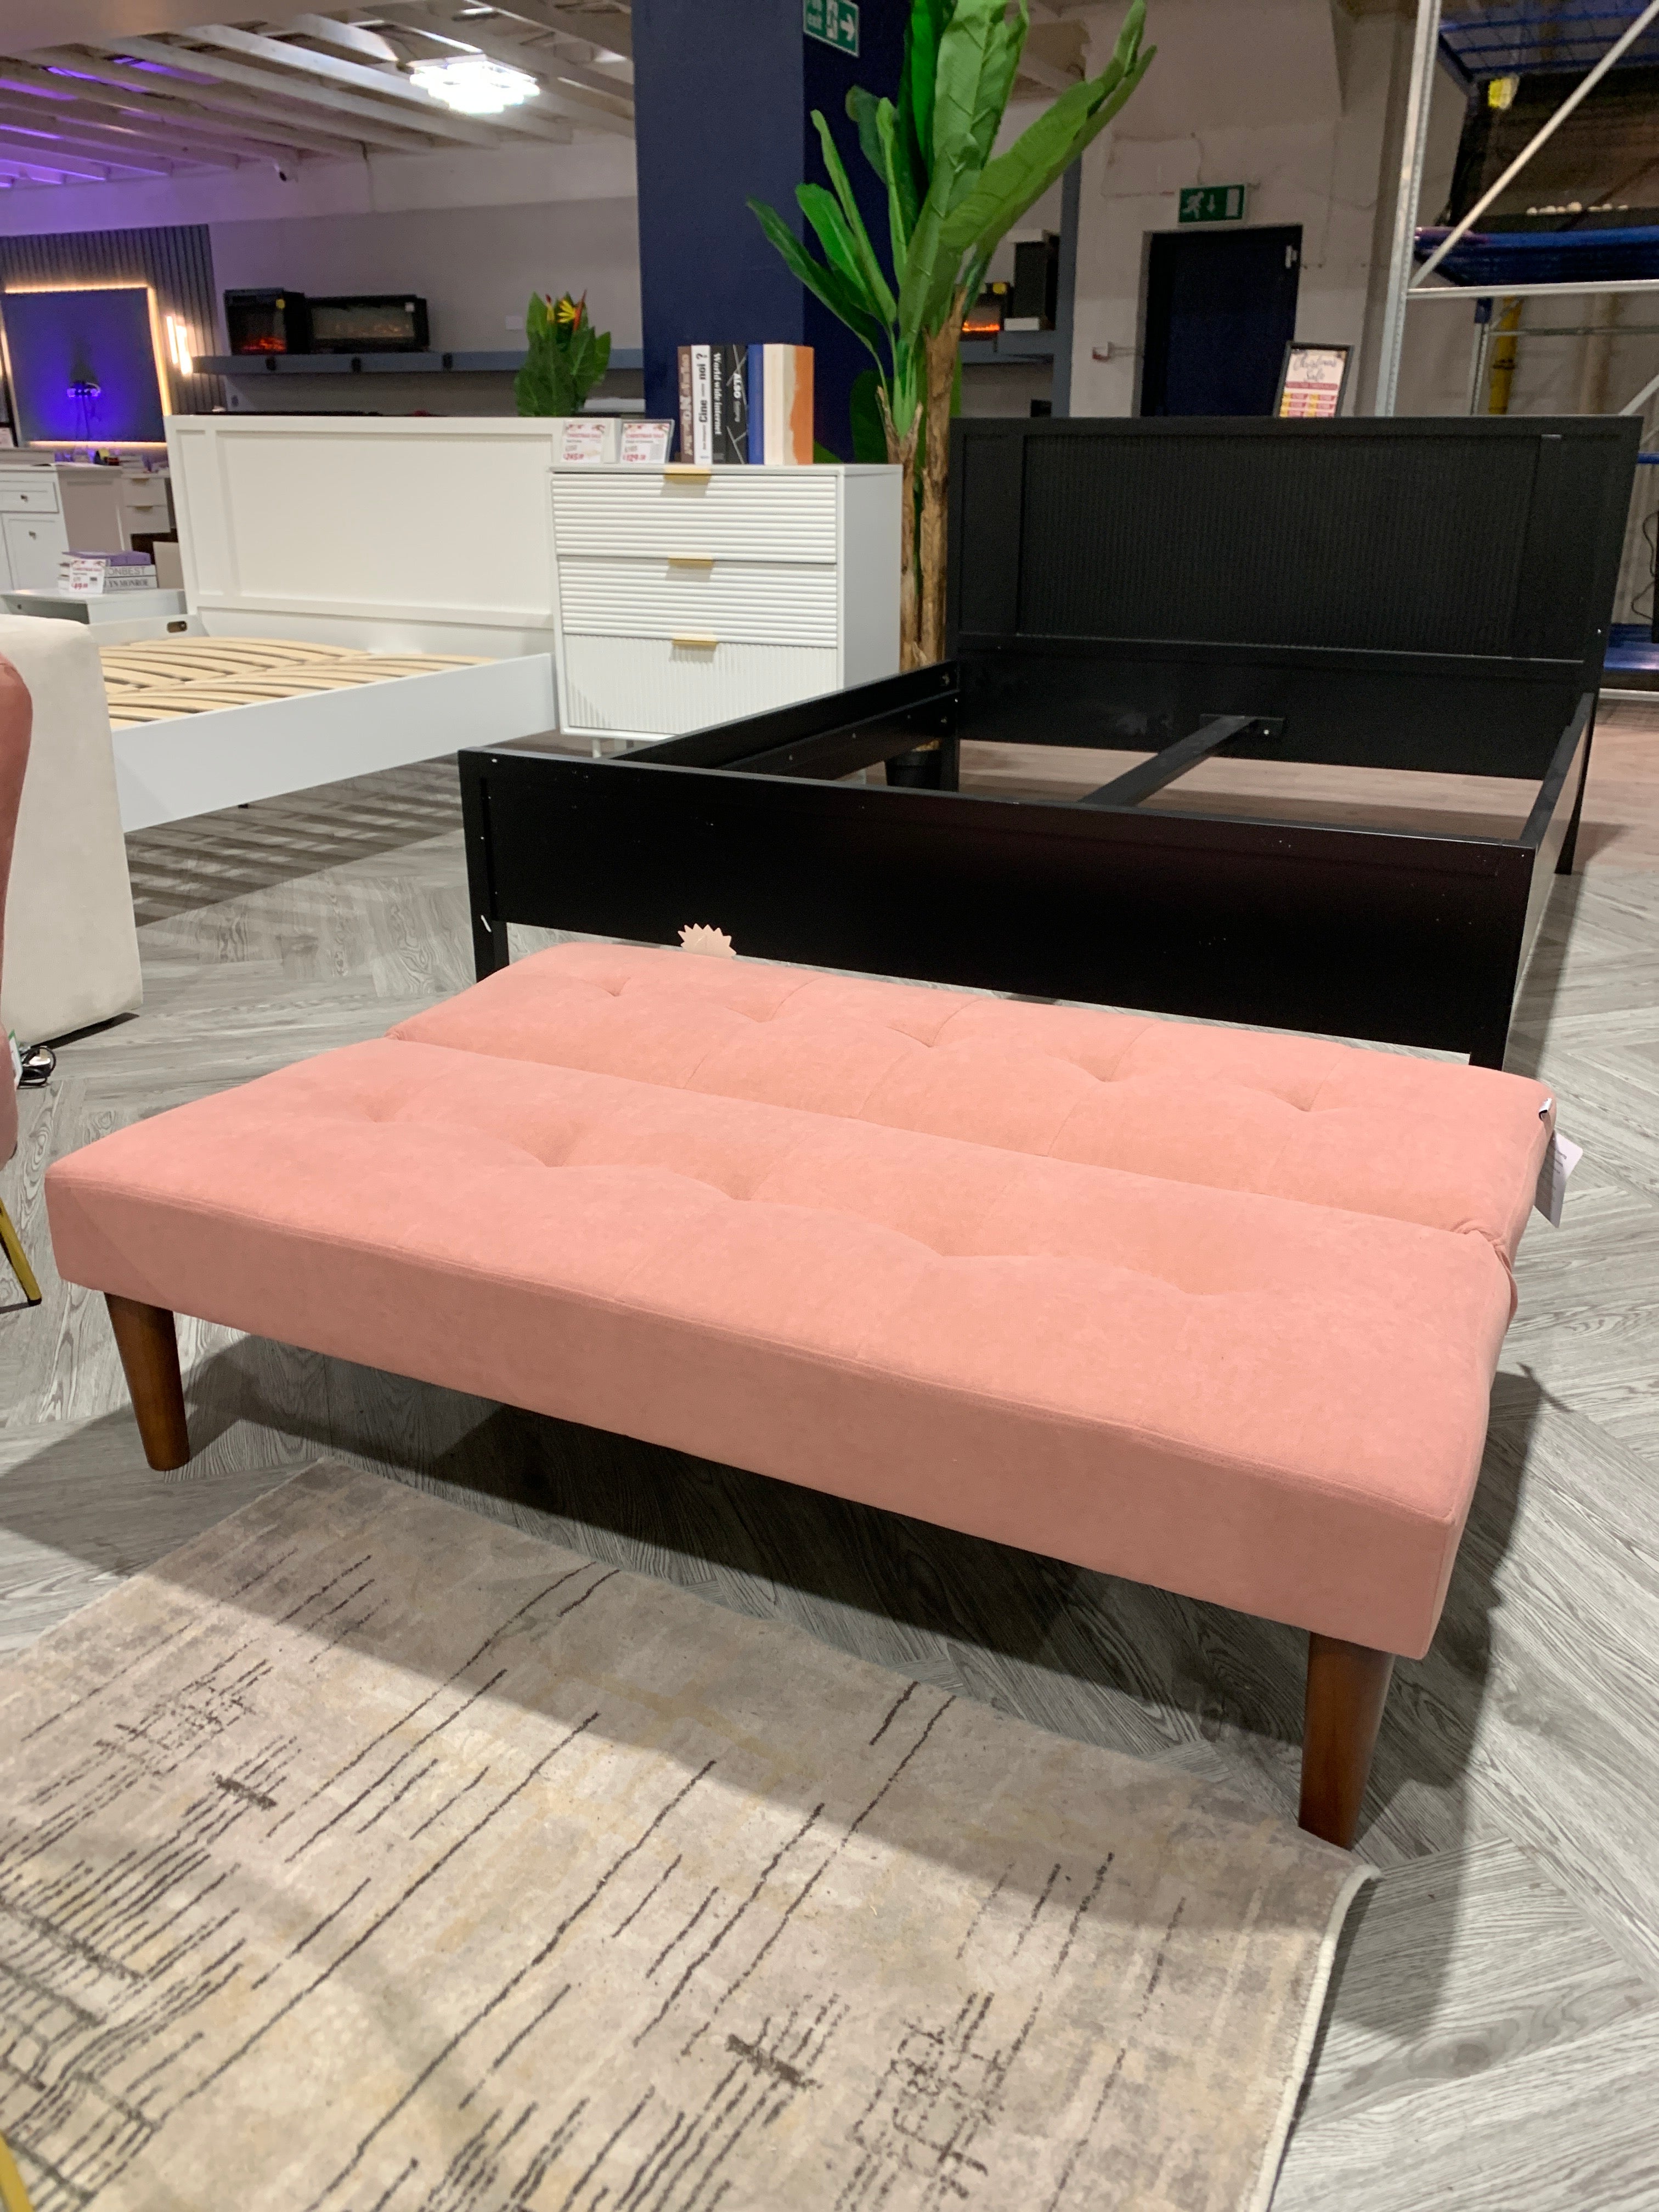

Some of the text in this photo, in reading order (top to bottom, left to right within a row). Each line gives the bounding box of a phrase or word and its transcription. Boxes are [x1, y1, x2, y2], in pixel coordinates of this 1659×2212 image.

[696, 364, 706, 380] noi
[713, 352, 722, 380] World
[698, 400, 708, 422] Cine
